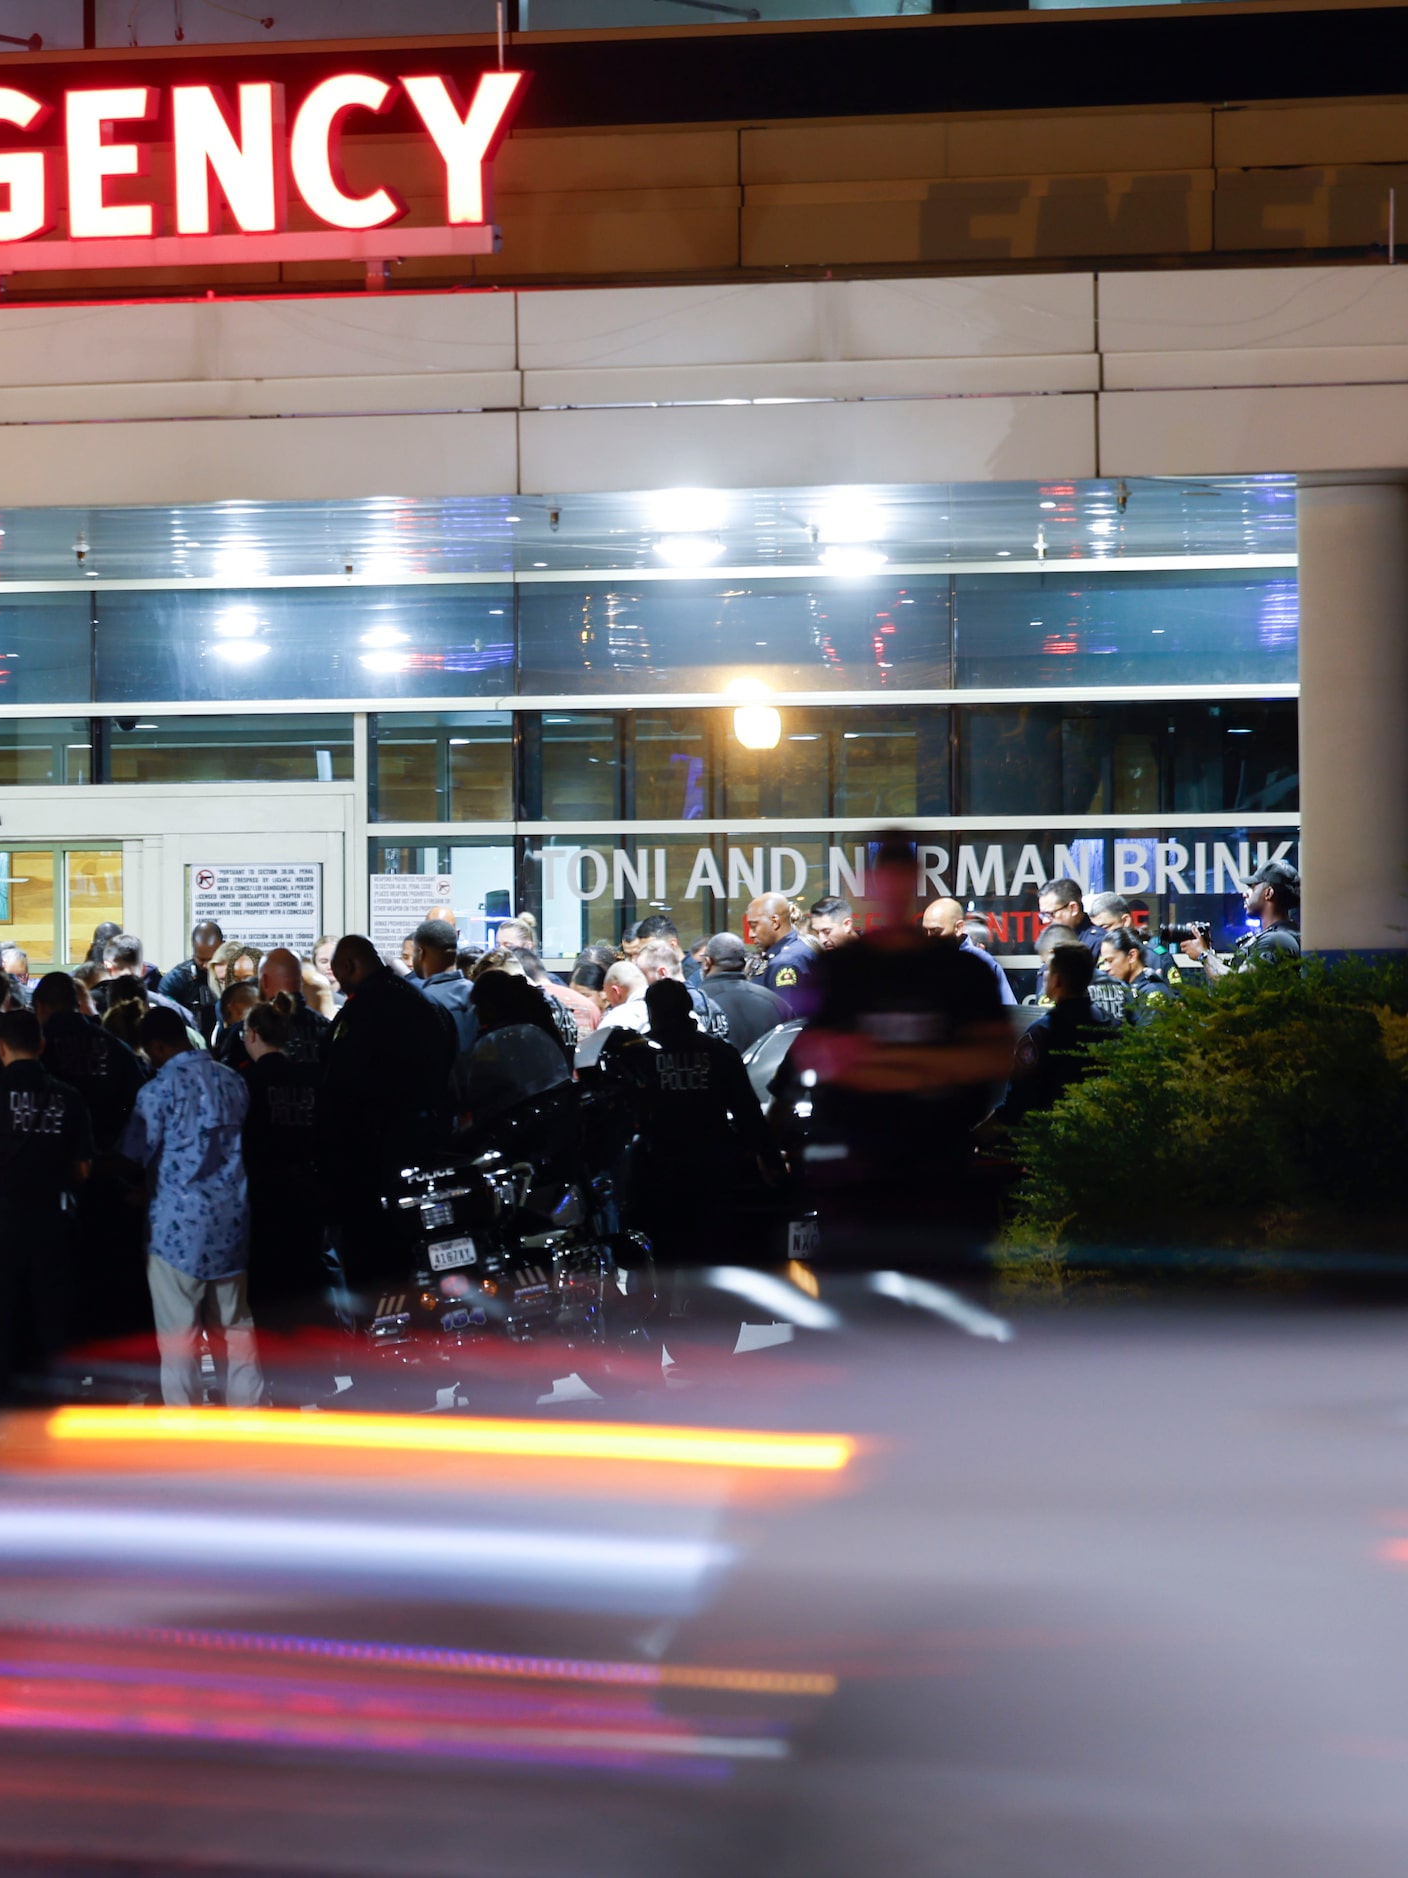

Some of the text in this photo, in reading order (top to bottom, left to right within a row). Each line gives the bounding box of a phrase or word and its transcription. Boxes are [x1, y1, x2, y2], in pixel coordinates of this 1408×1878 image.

[534, 847, 667, 901] TONI
[684, 847, 807, 899] AND
[829, 843, 1089, 898] NRMAN
[1087, 984, 1124, 1001] DALLAS
[656, 1052, 711, 1072] DALLAS
[660, 1071, 710, 1091] POLICE
[408, 1167, 455, 1184] POLICE
